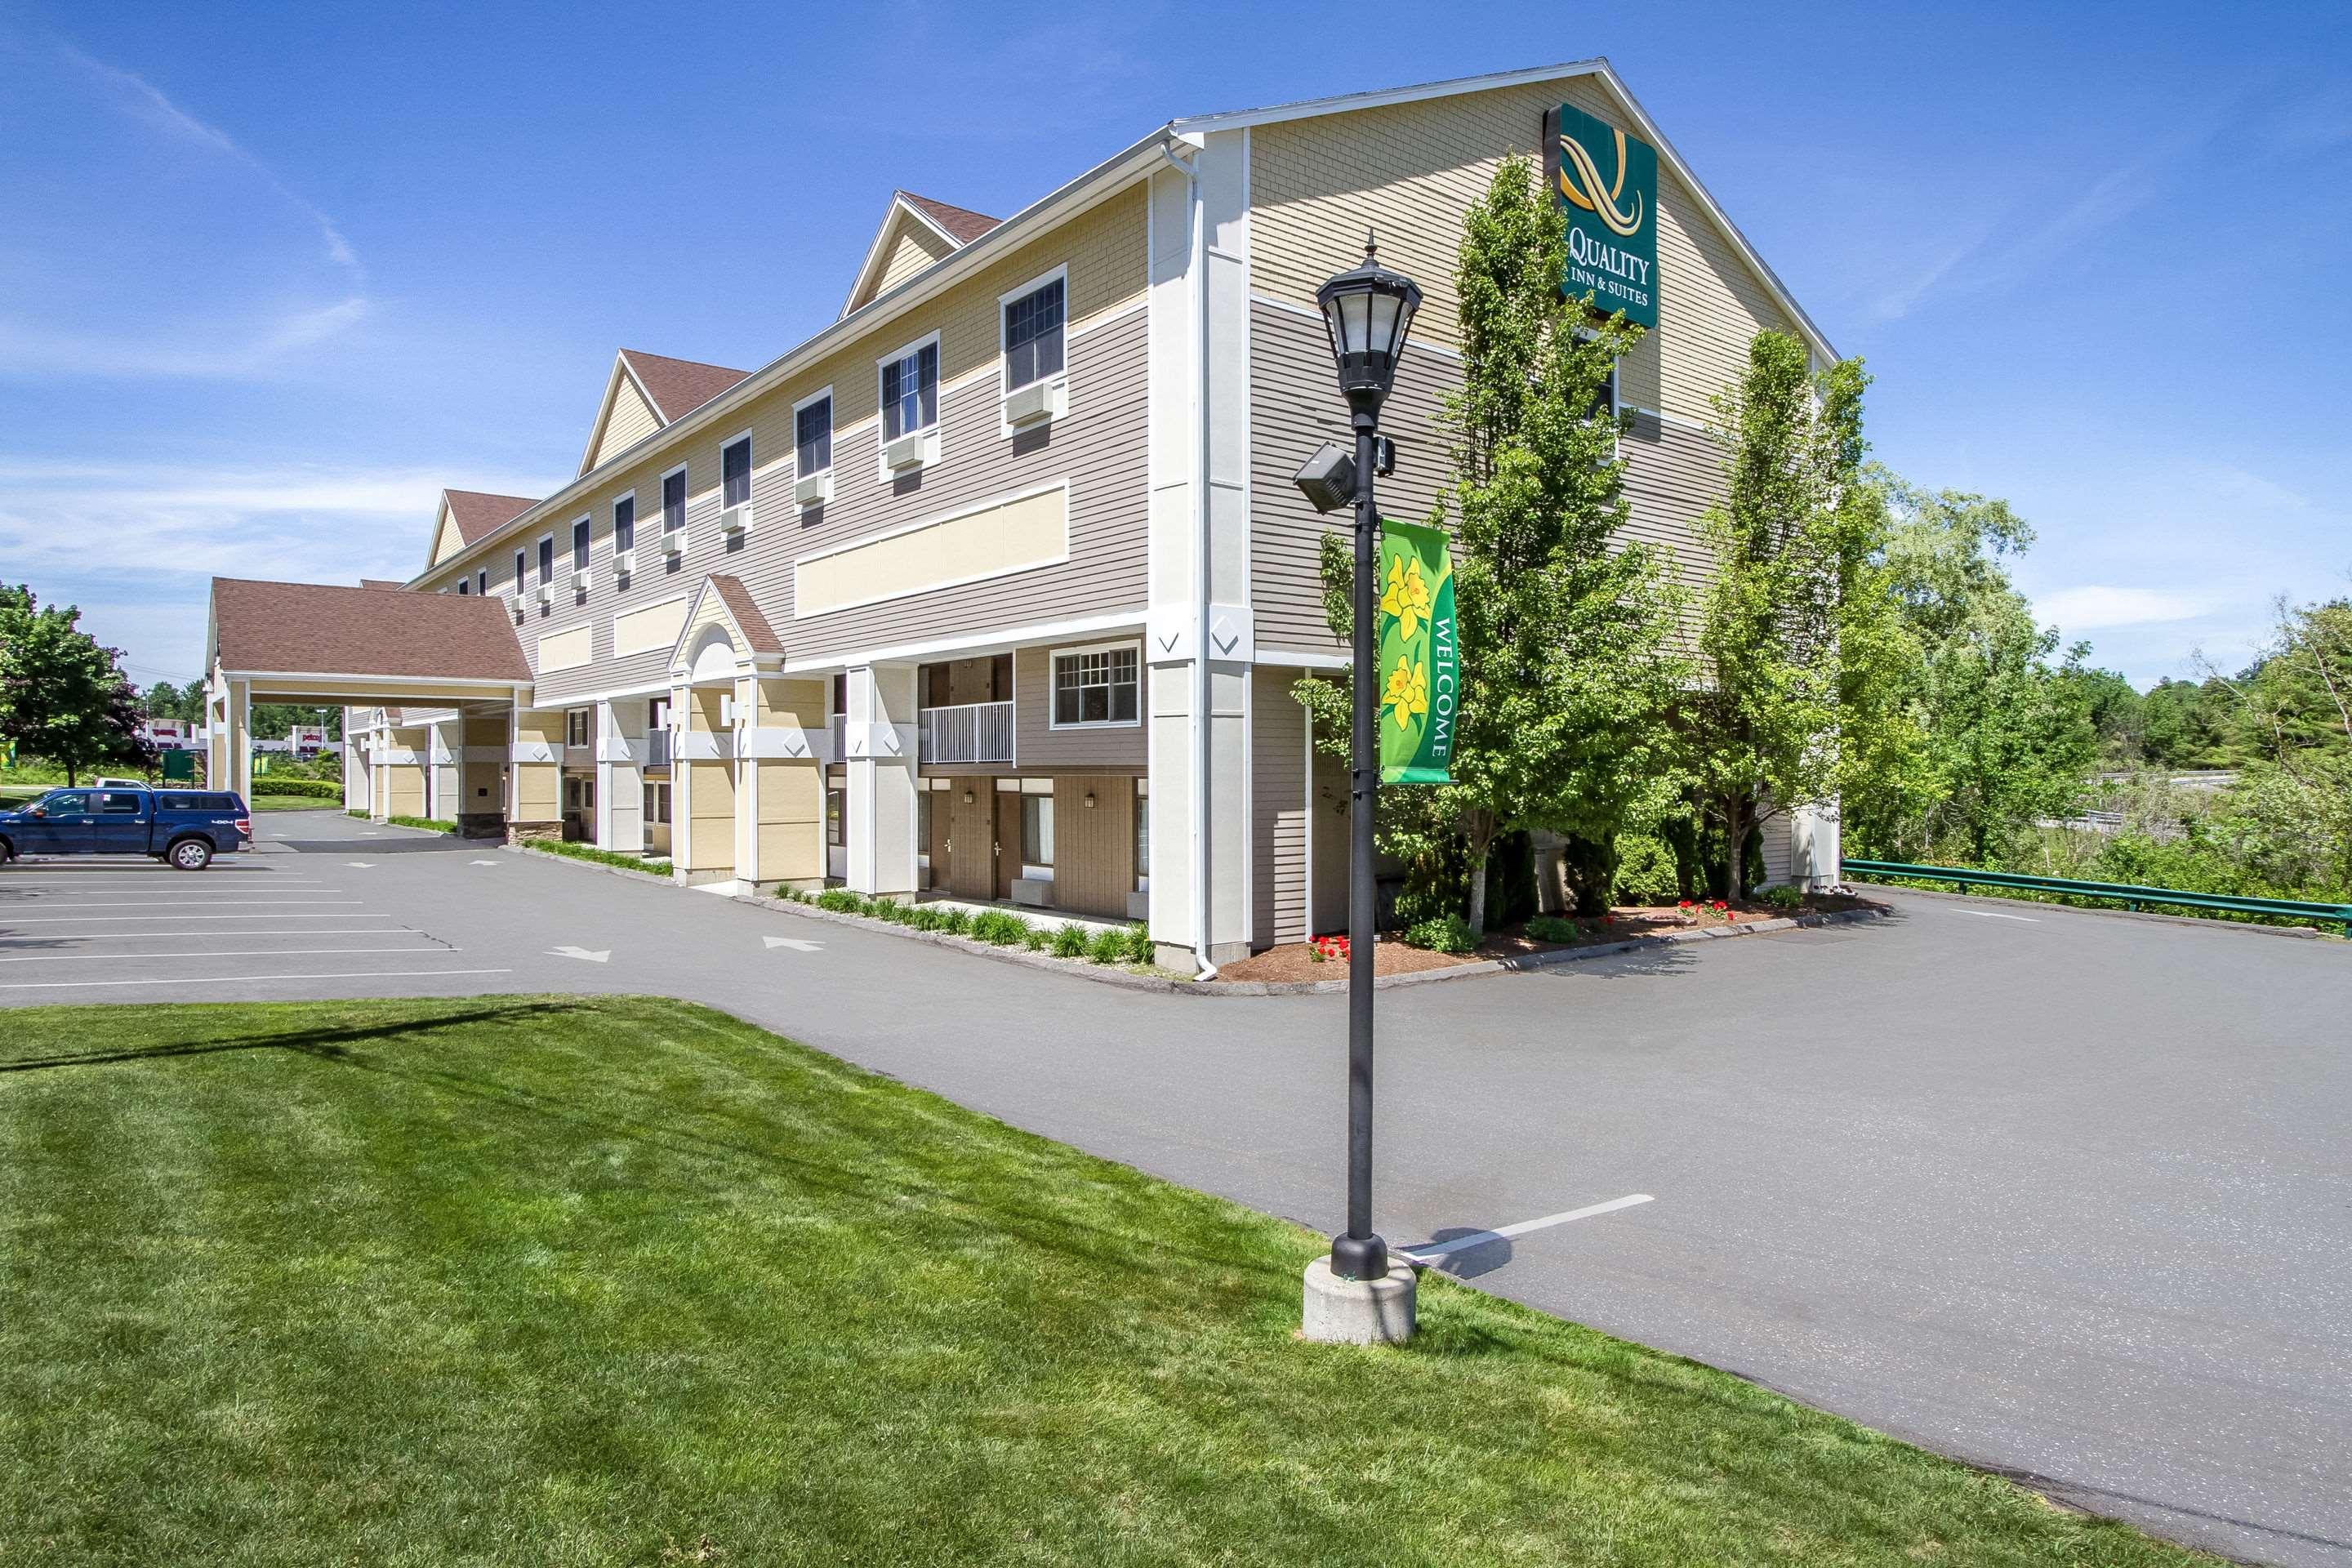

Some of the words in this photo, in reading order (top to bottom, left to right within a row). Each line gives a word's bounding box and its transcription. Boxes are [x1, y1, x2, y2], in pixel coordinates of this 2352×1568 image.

[1569, 226, 1650, 286] QUALITY
[1570, 266, 1595, 287] INN
[1597, 276, 1606, 291] &
[1608, 280, 1648, 306] SUITES
[1432, 617, 1454, 757] WELCOME
